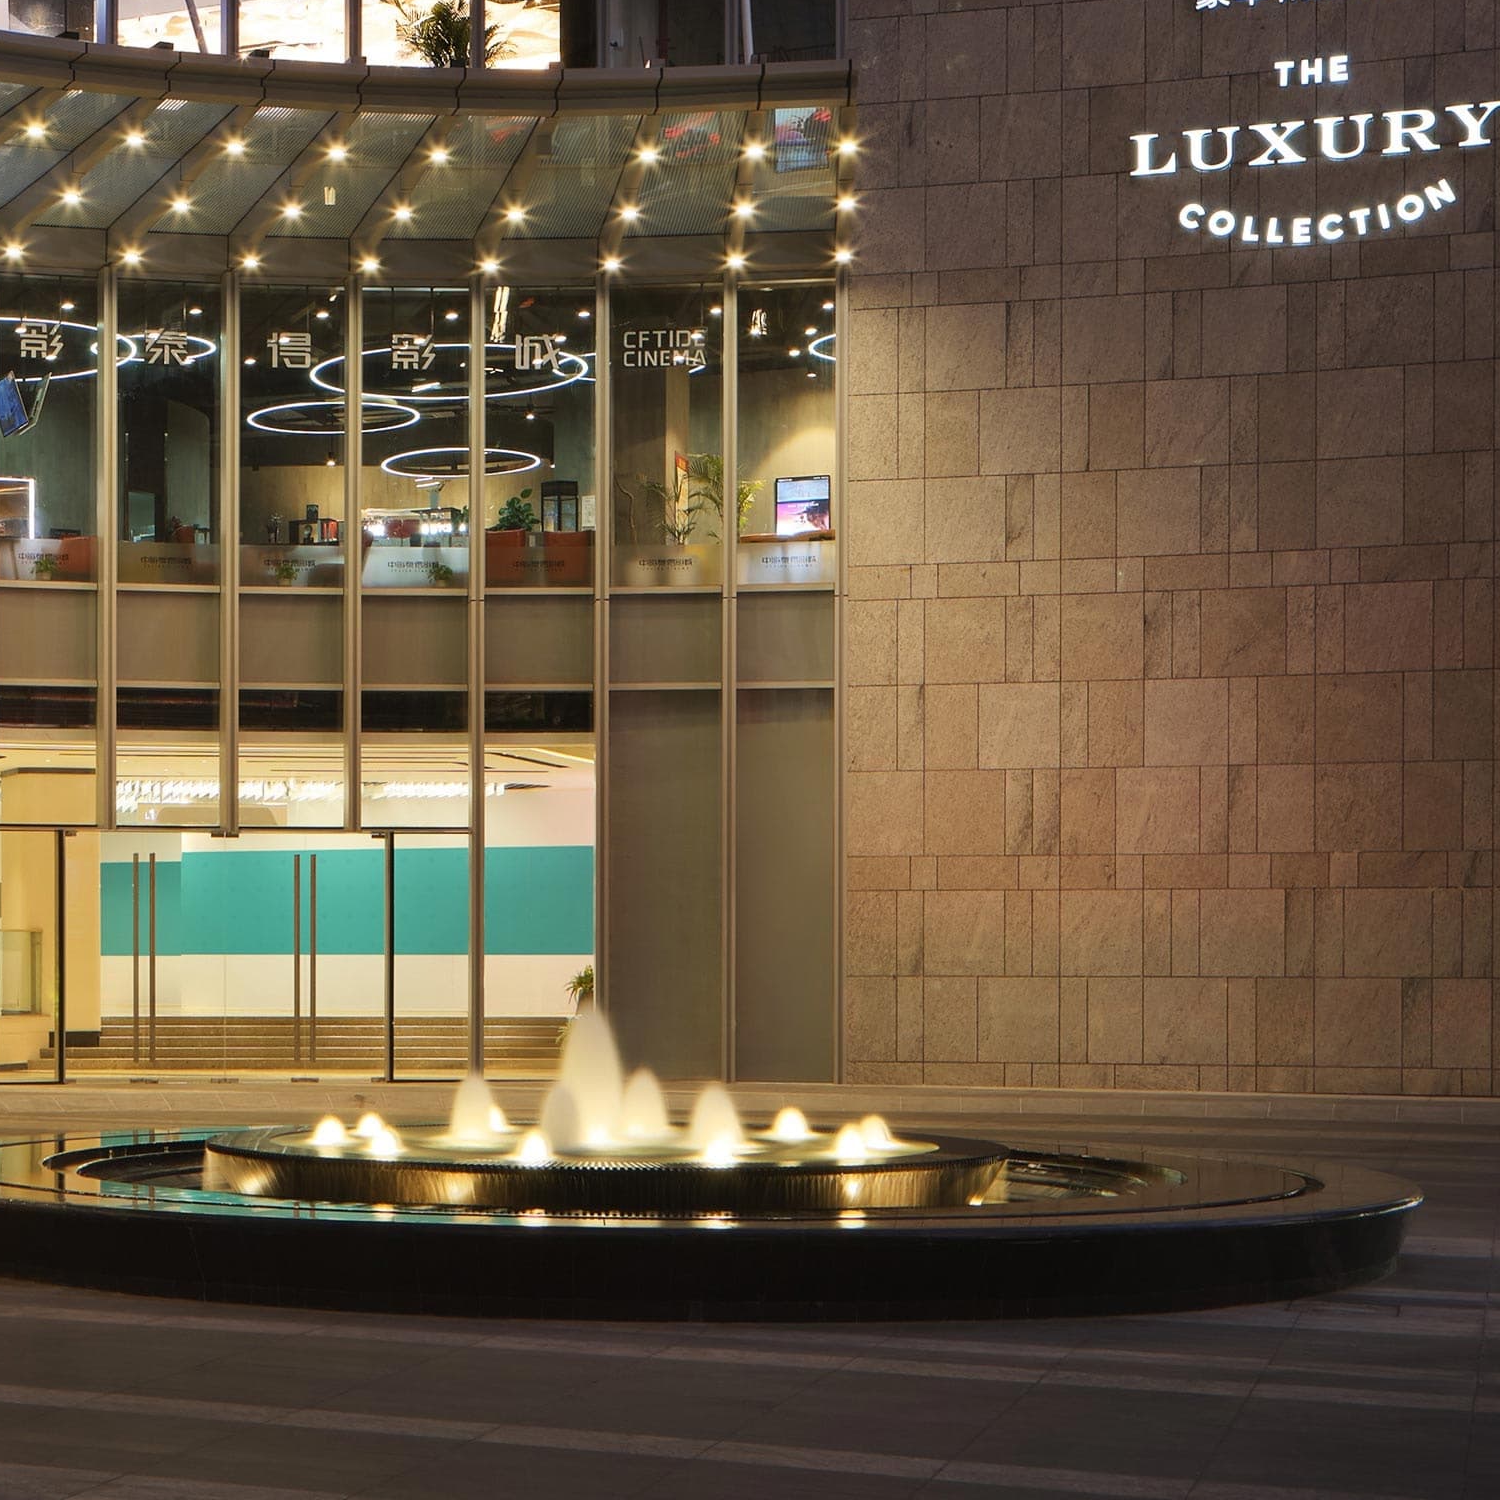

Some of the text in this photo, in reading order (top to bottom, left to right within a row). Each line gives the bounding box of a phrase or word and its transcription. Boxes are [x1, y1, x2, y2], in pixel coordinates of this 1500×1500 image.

[1273, 54, 1349, 87] THE
[1129, 100, 1500, 177] LUXURY
[1179, 178, 1456, 245] COLLECTION
[622, 349, 708, 368] CINEMA
